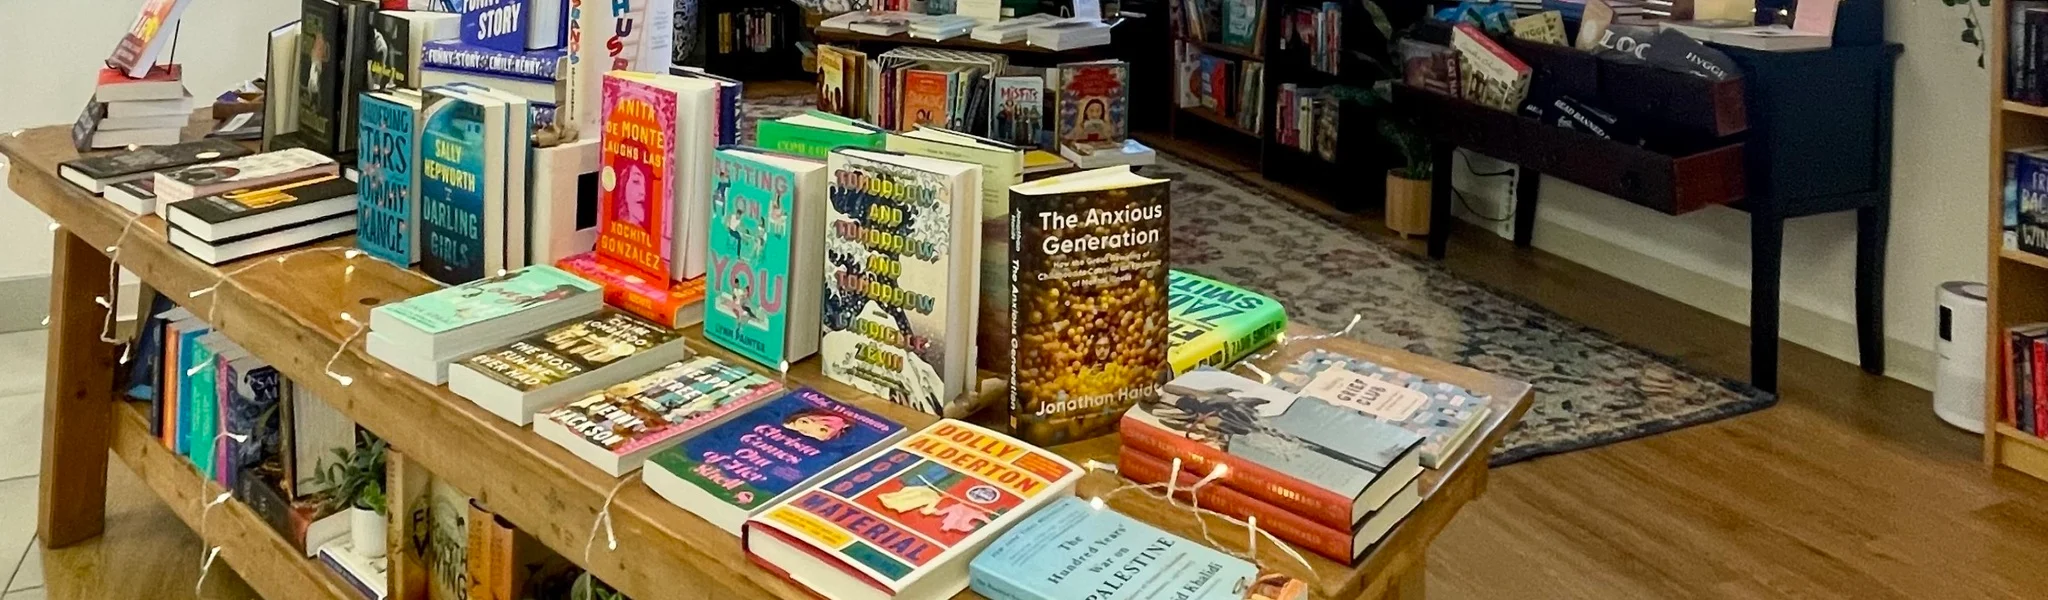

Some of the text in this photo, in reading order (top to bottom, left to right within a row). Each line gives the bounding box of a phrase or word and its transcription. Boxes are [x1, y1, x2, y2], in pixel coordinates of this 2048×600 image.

[477, 3, 521, 40] STORY
[429, 49, 480, 68] FUNNY STORY
[489, 54, 541, 74] EMILY HENRY
[1686, 52, 1727, 79] HYGGE
[617, 98, 655, 122] ANITA
[1554, 99, 1605, 137] READ BANNED
[435, 138, 462, 163] SALLY
[606, 121, 664, 149] DE MONTE
[603, 140, 667, 168] LAUGHS LAST
[423, 159, 476, 193] HEPWORTH
[715, 157, 788, 195] BETTING
[835, 169, 937, 208] TOMORROW
[2032, 171, 2048, 193] FR
[423, 196, 478, 240] DARLING
[735, 195, 760, 219] ON
[869, 203, 902, 227] AND
[1039, 204, 1162, 231] The Anxious
[431, 231, 469, 269] GIRLS
[610, 221, 652, 248] XOCHITL
[834, 219, 935, 260] TOMORROW
[1042, 227, 1159, 255] Generation
[601, 235, 661, 270] GONZALEZ
[867, 253, 902, 279] AND
[711, 251, 784, 314] YOU
[835, 270, 936, 316] TOMORROW
[837, 311, 928, 355] GABRIELLE
[1010, 259, 1020, 410] The Anxious Generation
[471, 354, 510, 372] EVER
[505, 369, 541, 385] HAD
[497, 350, 530, 366] FUN
[528, 363, 560, 380] WE
[511, 342, 541, 355] THE
[536, 352, 582, 374] MOST
[854, 341, 903, 374] ZEVIN
[1036, 392, 1114, 417] Jonathan
[1337, 378, 1368, 401] GRIEF
[1356, 386, 1386, 406] CLUB
[550, 409, 624, 446] JACKSON
[589, 403, 649, 432] JENNY
[934, 423, 1015, 456] DOLLY
[908, 436, 1041, 493] ALDERTON
[801, 494, 931, 562] MATERIAL
[1057, 535, 1083, 551] The
[1047, 546, 1099, 584] Hundred
[1085, 536, 1176, 600] PALESTINE
[1088, 546, 1130, 574] War on
[1183, 561, 1223, 593] Khalidi
